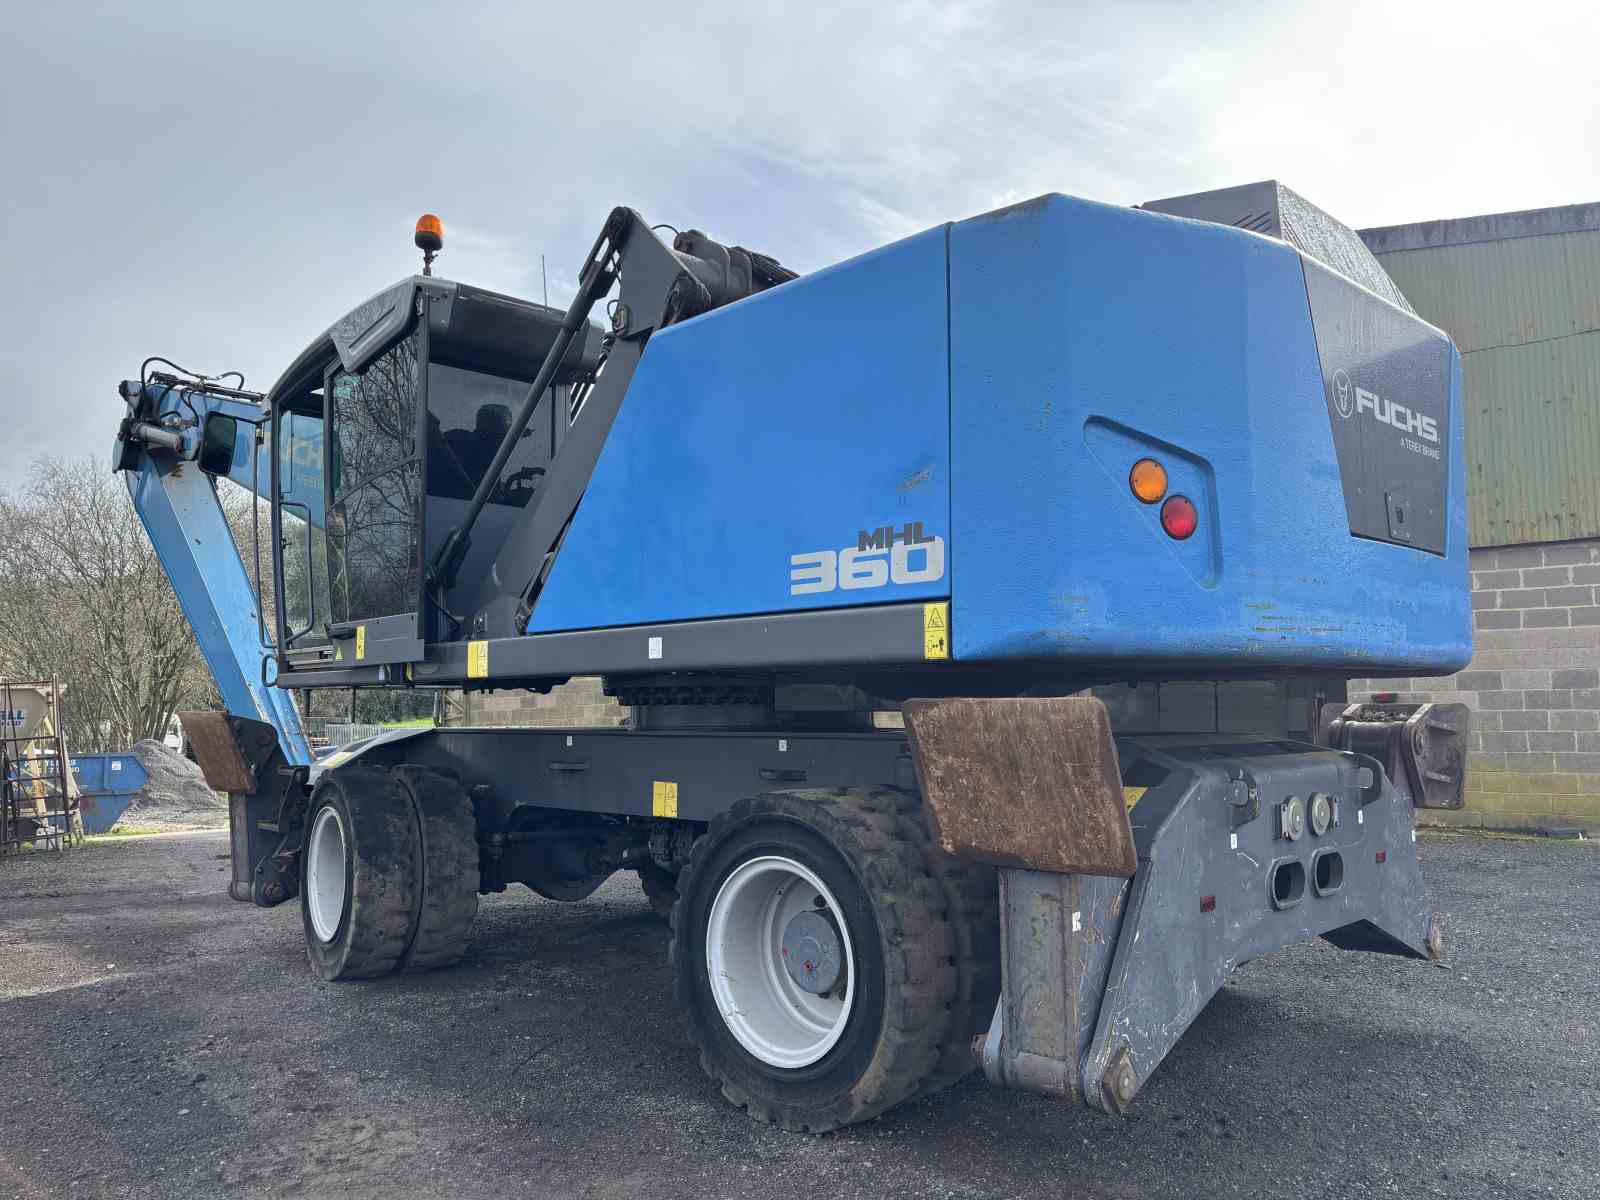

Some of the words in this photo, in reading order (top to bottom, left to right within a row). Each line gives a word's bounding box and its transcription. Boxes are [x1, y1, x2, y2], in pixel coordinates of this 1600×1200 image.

[1355, 387, 1437, 442] FUCHS
[1406, 439, 1421, 453] TEREX
[858, 521, 935, 551] MHL
[791, 536, 944, 595] 360
